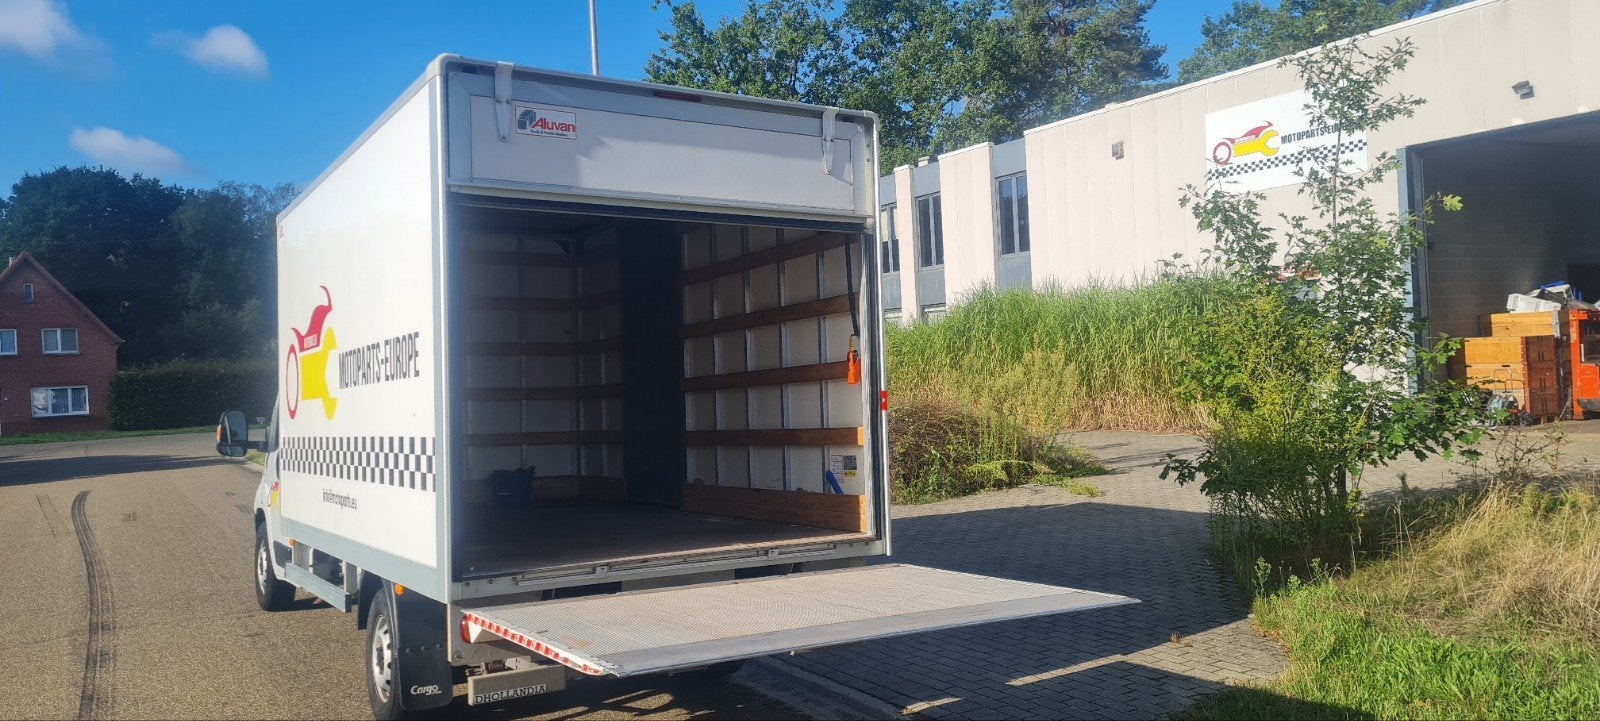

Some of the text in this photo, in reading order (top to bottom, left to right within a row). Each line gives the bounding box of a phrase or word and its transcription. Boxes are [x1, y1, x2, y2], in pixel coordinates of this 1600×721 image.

[530, 117, 576, 132] Aluvan
[1281, 121, 1353, 144] MOTOPARTS-EU
[338, 331, 419, 389] MOTOPARTS-EUROPE
[475, 684, 546, 703] DHOLLANDIA
